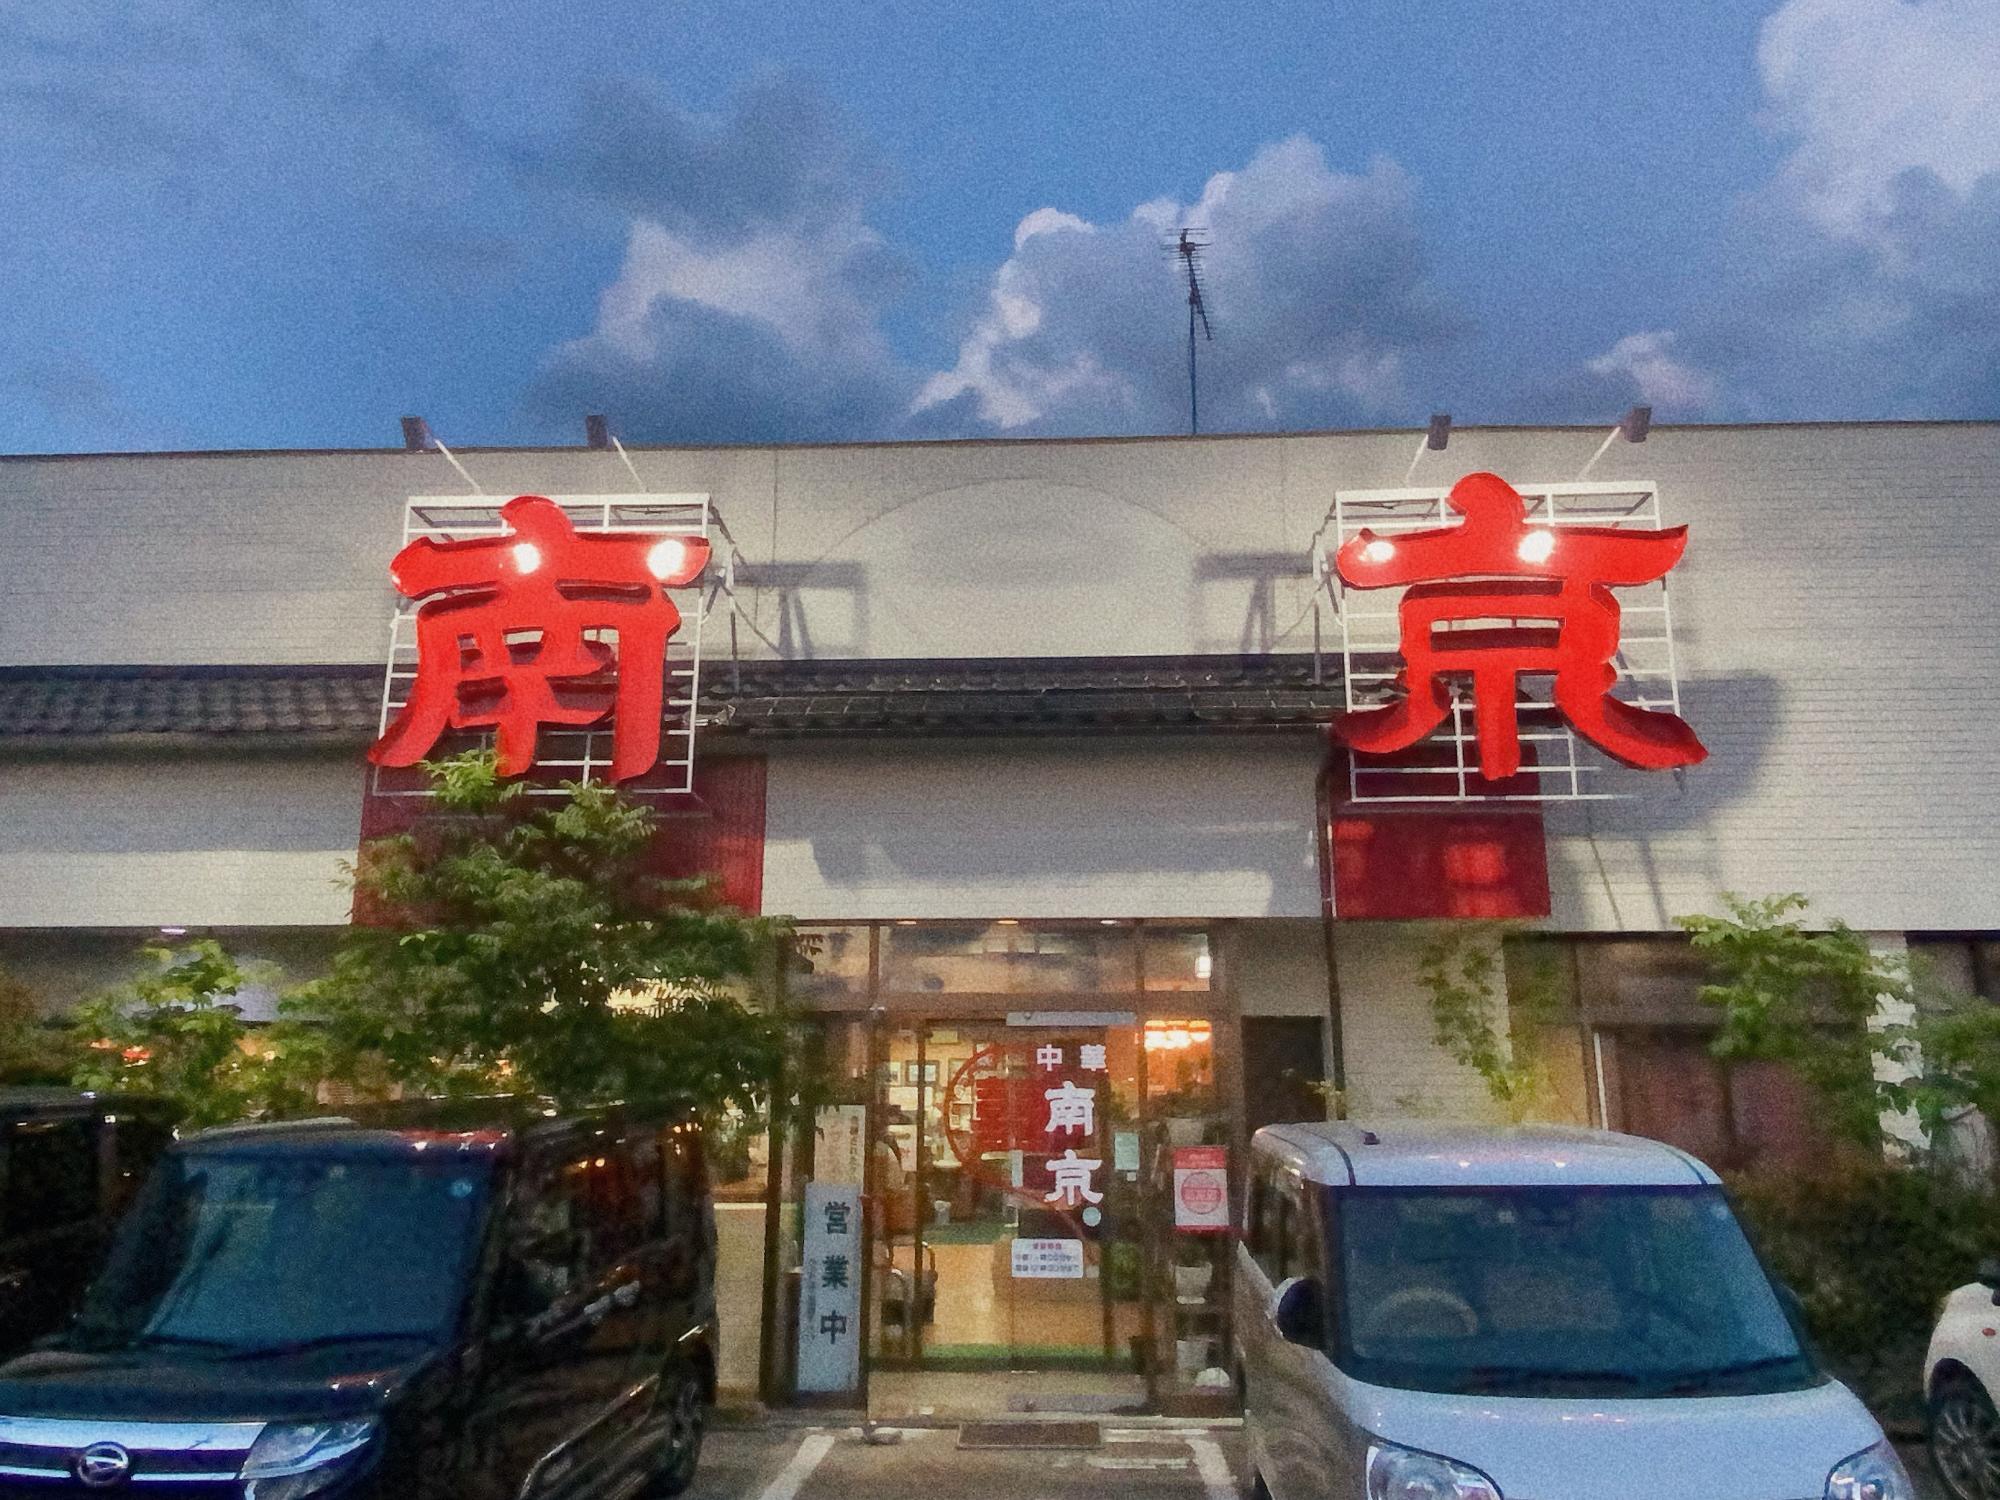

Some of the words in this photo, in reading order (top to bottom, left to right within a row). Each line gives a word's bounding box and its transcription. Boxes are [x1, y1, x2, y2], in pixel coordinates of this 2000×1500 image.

[367, 495, 712, 782] 南
[1331, 471, 1709, 781] 京
[1044, 1080, 1103, 1205] 南京
[820, 1201, 850, 1344] 営業中
